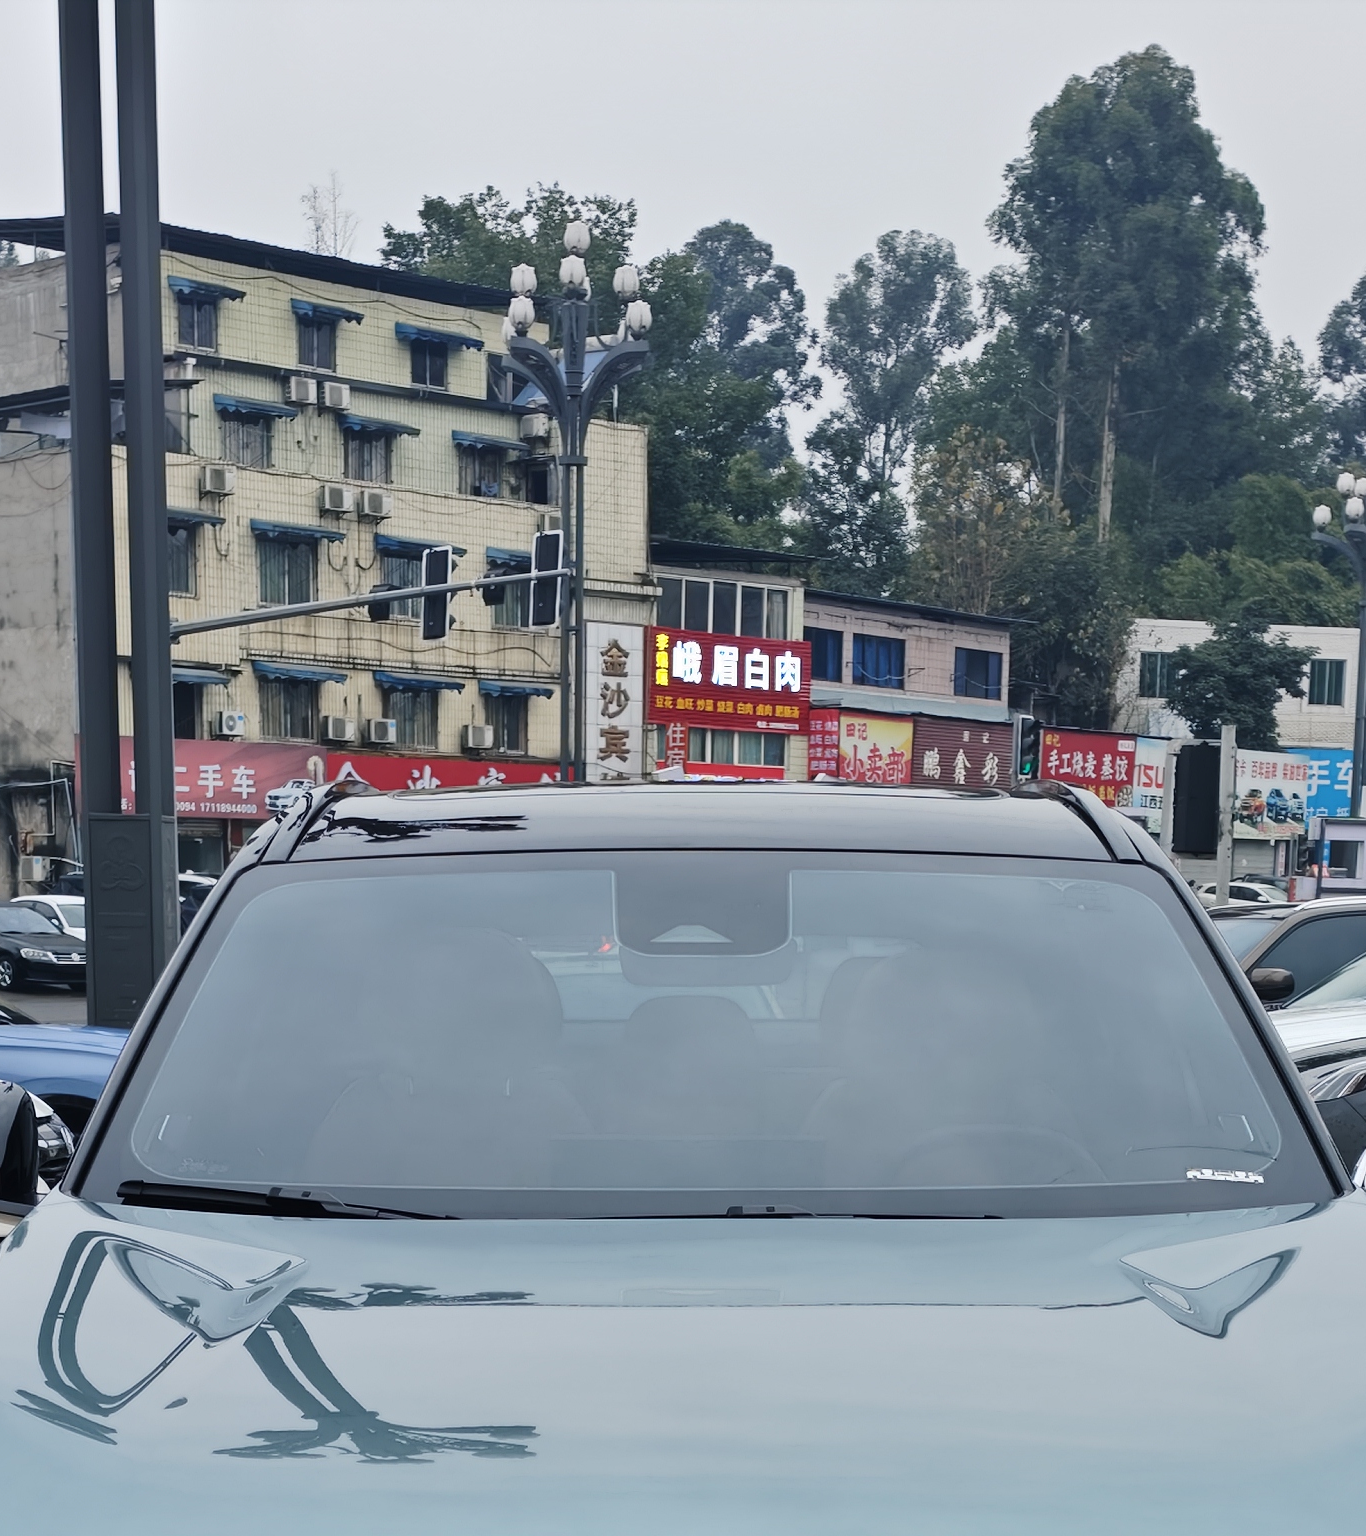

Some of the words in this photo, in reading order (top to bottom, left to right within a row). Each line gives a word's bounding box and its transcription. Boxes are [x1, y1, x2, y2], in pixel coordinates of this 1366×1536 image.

[672, 640, 802, 693] 峨眉白肉
[599, 638, 631, 781] 金沙宾
[737, 703, 754, 715] 白肉
[666, 722, 686, 767] 住宿
[844, 742, 906, 784] 小卖部
[1047, 749, 1097, 779] 手工烧麦
[1100, 753, 1129, 782] 蒸饺
